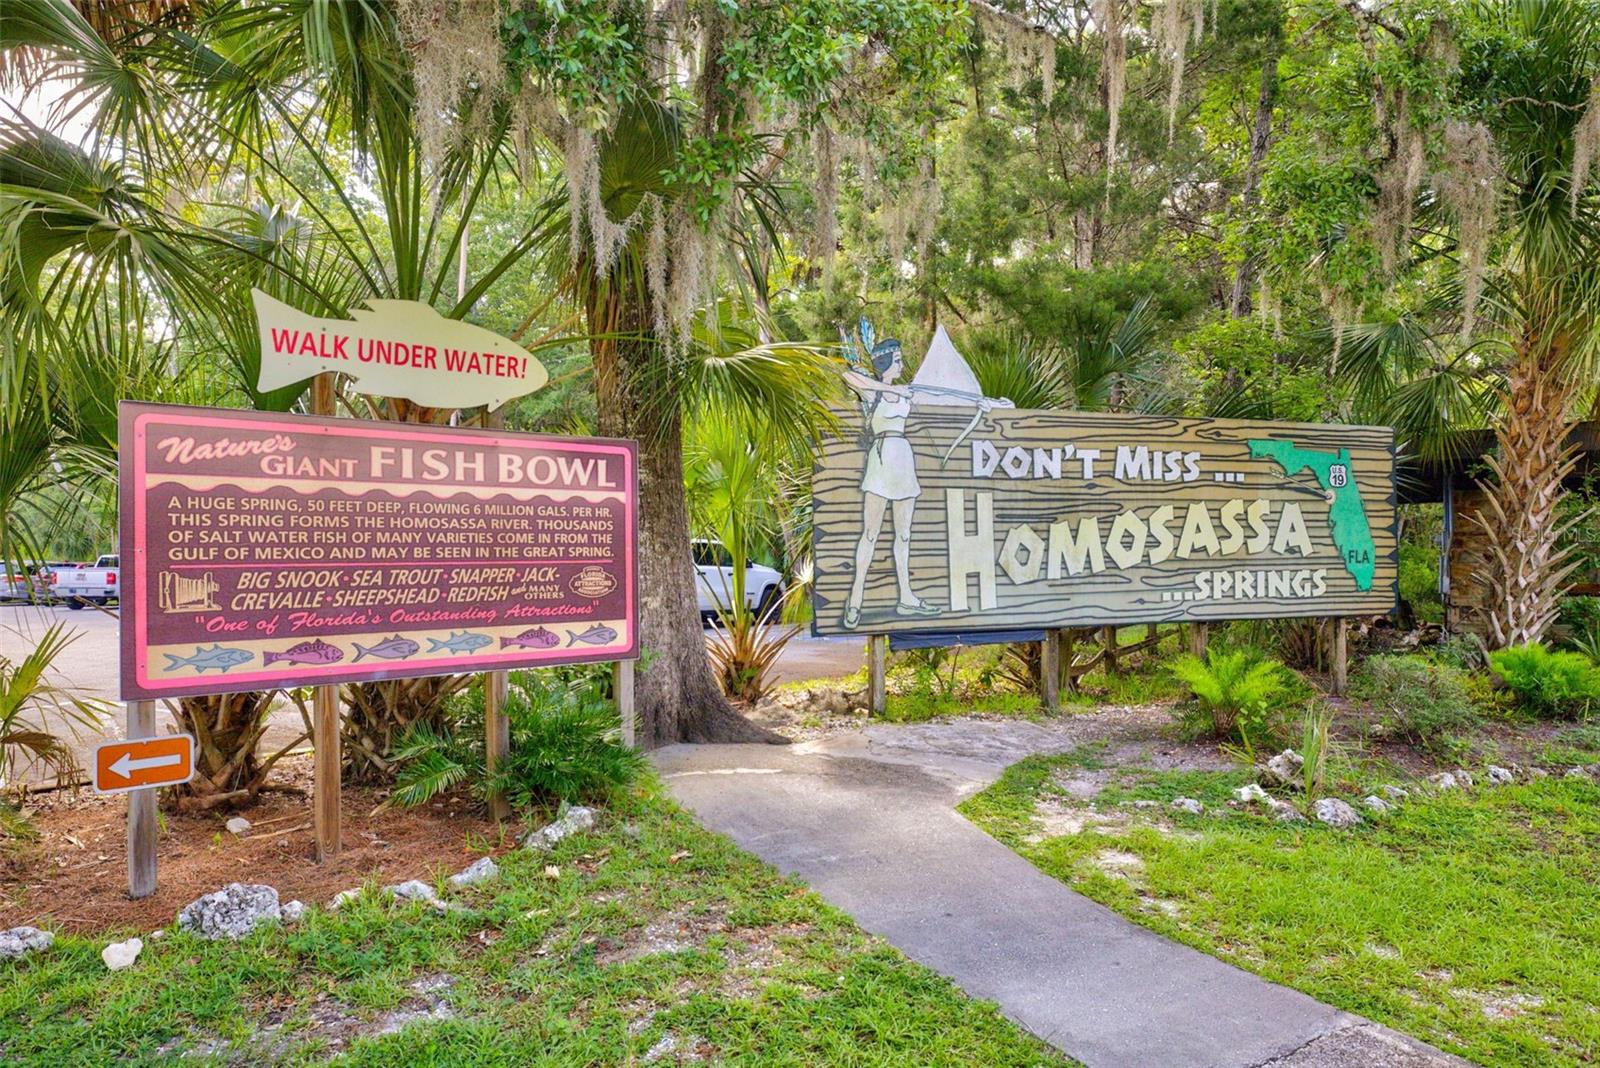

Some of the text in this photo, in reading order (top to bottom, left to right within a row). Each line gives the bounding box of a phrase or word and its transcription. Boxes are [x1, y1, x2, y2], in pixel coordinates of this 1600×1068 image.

[271, 328, 527, 379] WALK UNDER WATER!
[157, 434, 296, 464] Nature's
[260, 446, 616, 488] GIANT FISH BOWL
[972, 440, 1100, 479] DON'T
[1114, 445, 1200, 481] MISS
[1331, 474, 1344, 486] 19
[168, 496, 612, 518] A HUGE SPRING, 50 FEET DEEP, FLOWING 6 MILLION GALS. PER HR.
[168, 513, 614, 531] THIS SPRING FORMS THE HOMOSASSA RIVER. THOUSANDS
[168, 531, 613, 544] OF SALT WATER FISH OF MANY VARIETIES COME IN FROM THE
[168, 546, 615, 560] GULF OF MEXICO AND MAY BE SEEN IN THE GREAT SPRING.
[945, 488, 1313, 611] HOMOSASSA
[1348, 550, 1370, 564] FLA
[237, 567, 560, 589] BIG SNOOK SEA TROUT SNAPPER JACK-
[528, 584, 560, 593] MANY
[231, 583, 527, 610] CREVALLE SHEEPSHEAD REDFISH and
[524, 591, 565, 600] OTHERS
[255, 614, 280, 635] of
[287, 608, 382, 631] Florida's
[390, 606, 497, 623] Outstanding
